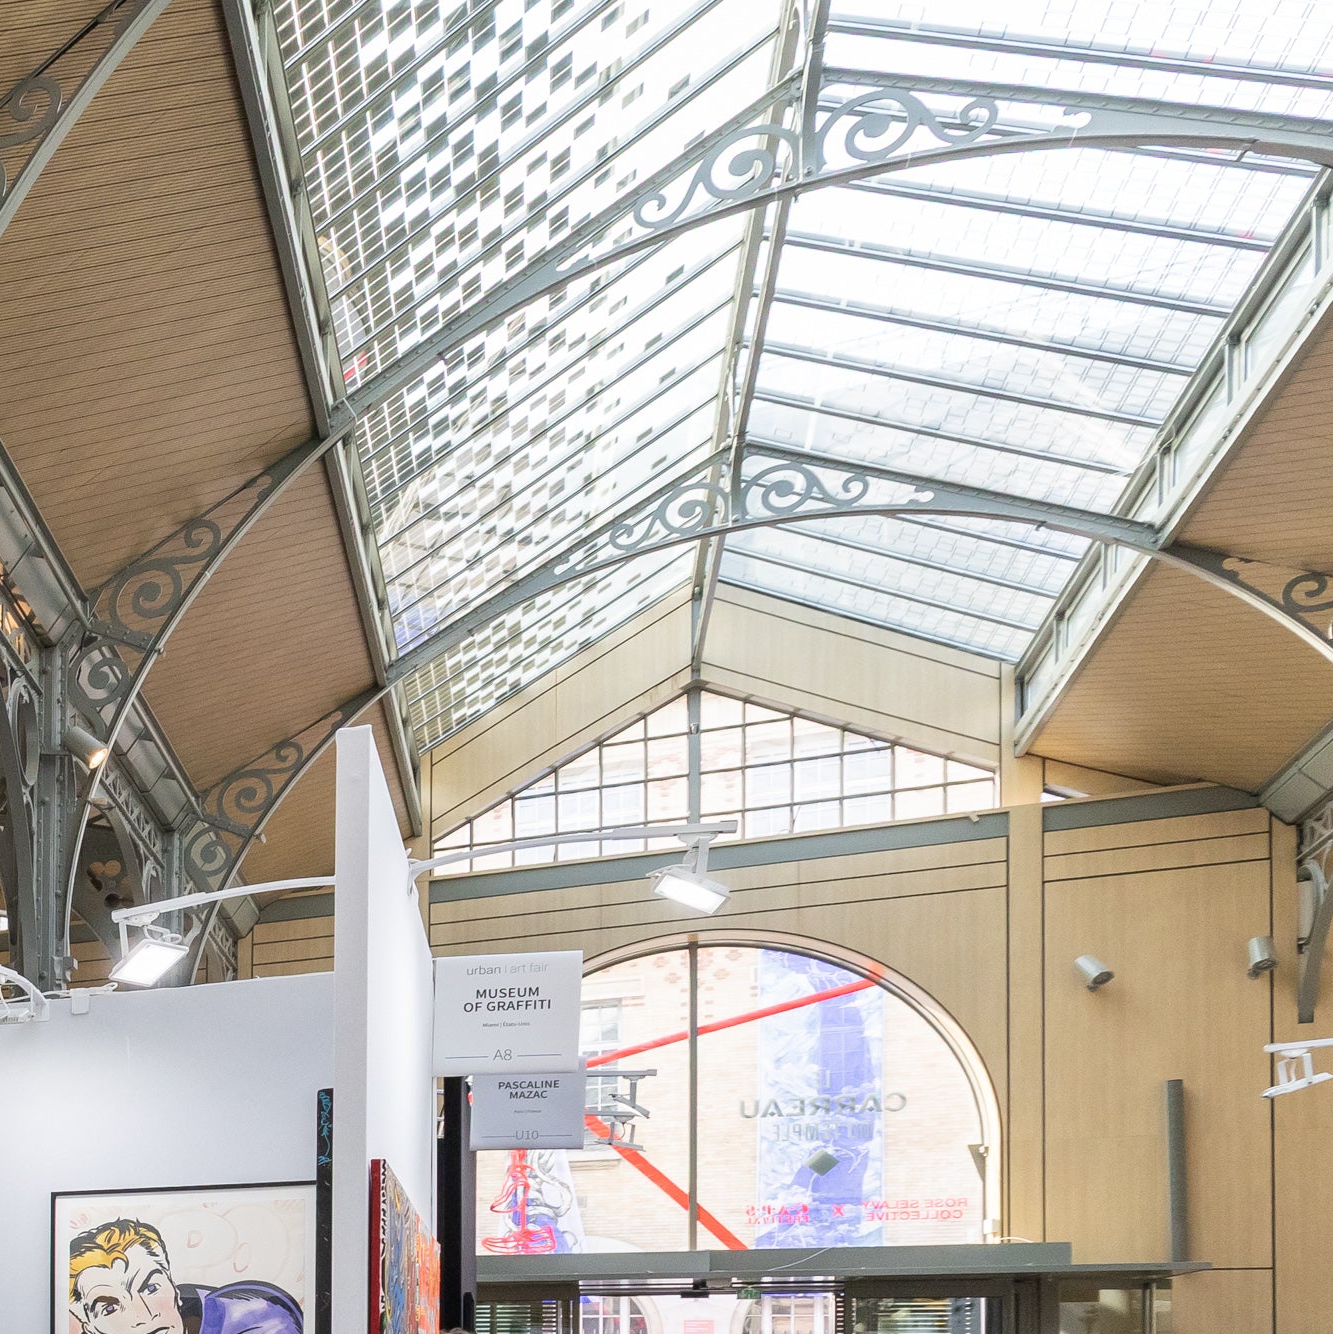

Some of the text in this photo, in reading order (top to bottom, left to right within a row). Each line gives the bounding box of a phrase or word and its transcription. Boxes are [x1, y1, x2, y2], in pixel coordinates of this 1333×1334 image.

[466, 963, 549, 976] urban art fair
[475, 986, 540, 999] MUSEUM
[463, 999, 552, 1013] OF GRAFFITI
[493, 1049, 513, 1061] A8
[498, 1079, 560, 1090] PASCALINE
[509, 1090, 548, 1100] MAZAC
[515, 1130, 540, 1141] U10
